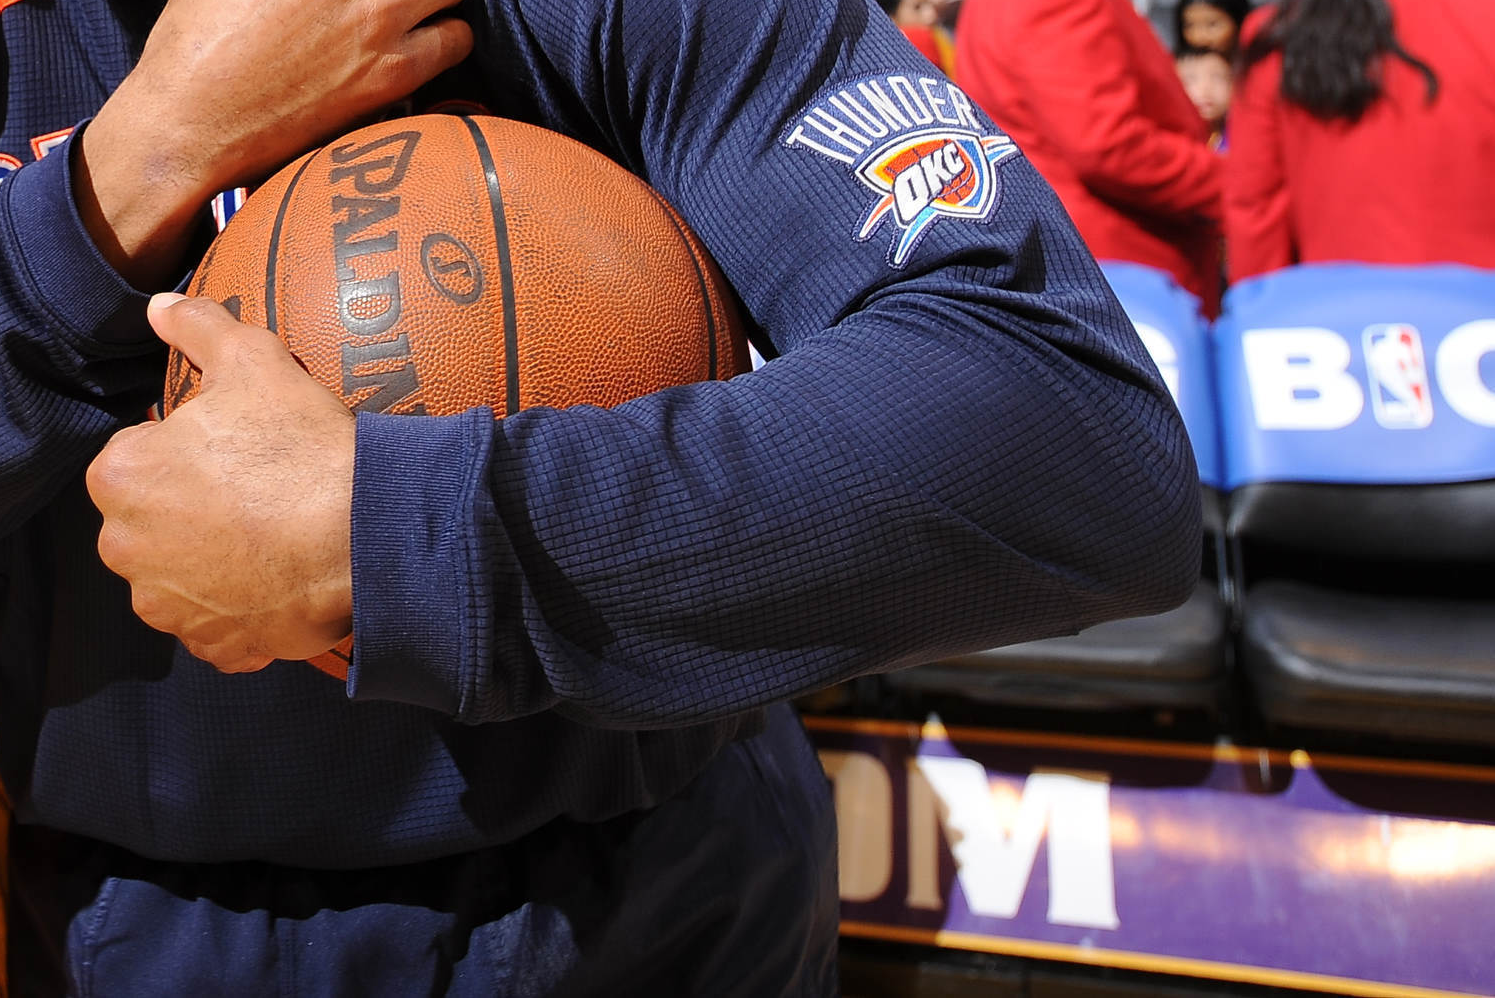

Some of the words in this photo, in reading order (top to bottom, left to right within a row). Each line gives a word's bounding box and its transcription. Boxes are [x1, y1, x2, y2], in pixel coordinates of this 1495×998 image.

[785, 75, 983, 164] THUNDER
[892, 140, 966, 224] OKC
[329, 130, 427, 416] SPALDIN
